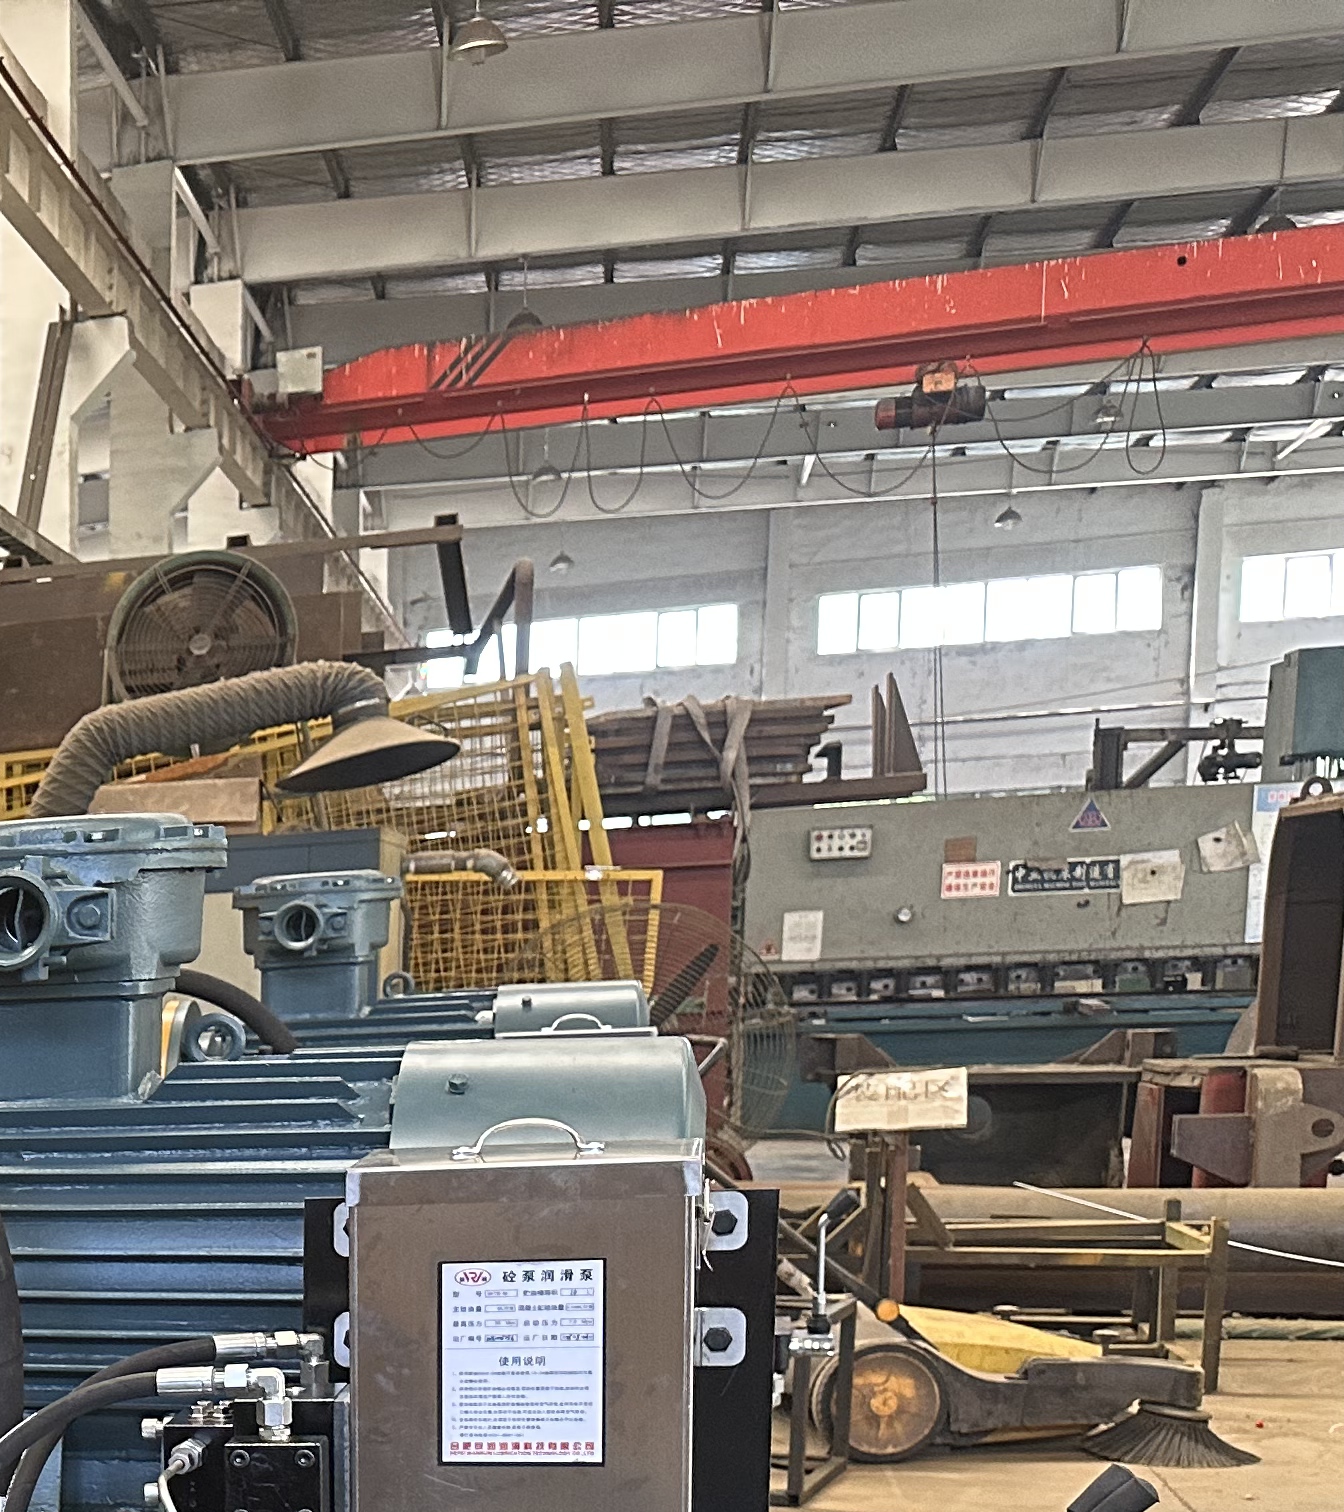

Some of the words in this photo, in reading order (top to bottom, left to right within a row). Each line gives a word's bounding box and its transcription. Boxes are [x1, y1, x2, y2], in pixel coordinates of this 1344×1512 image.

[502, 1268, 594, 1283] 砼泵润滑泵
[499, 1356, 547, 1367] 使用说明
